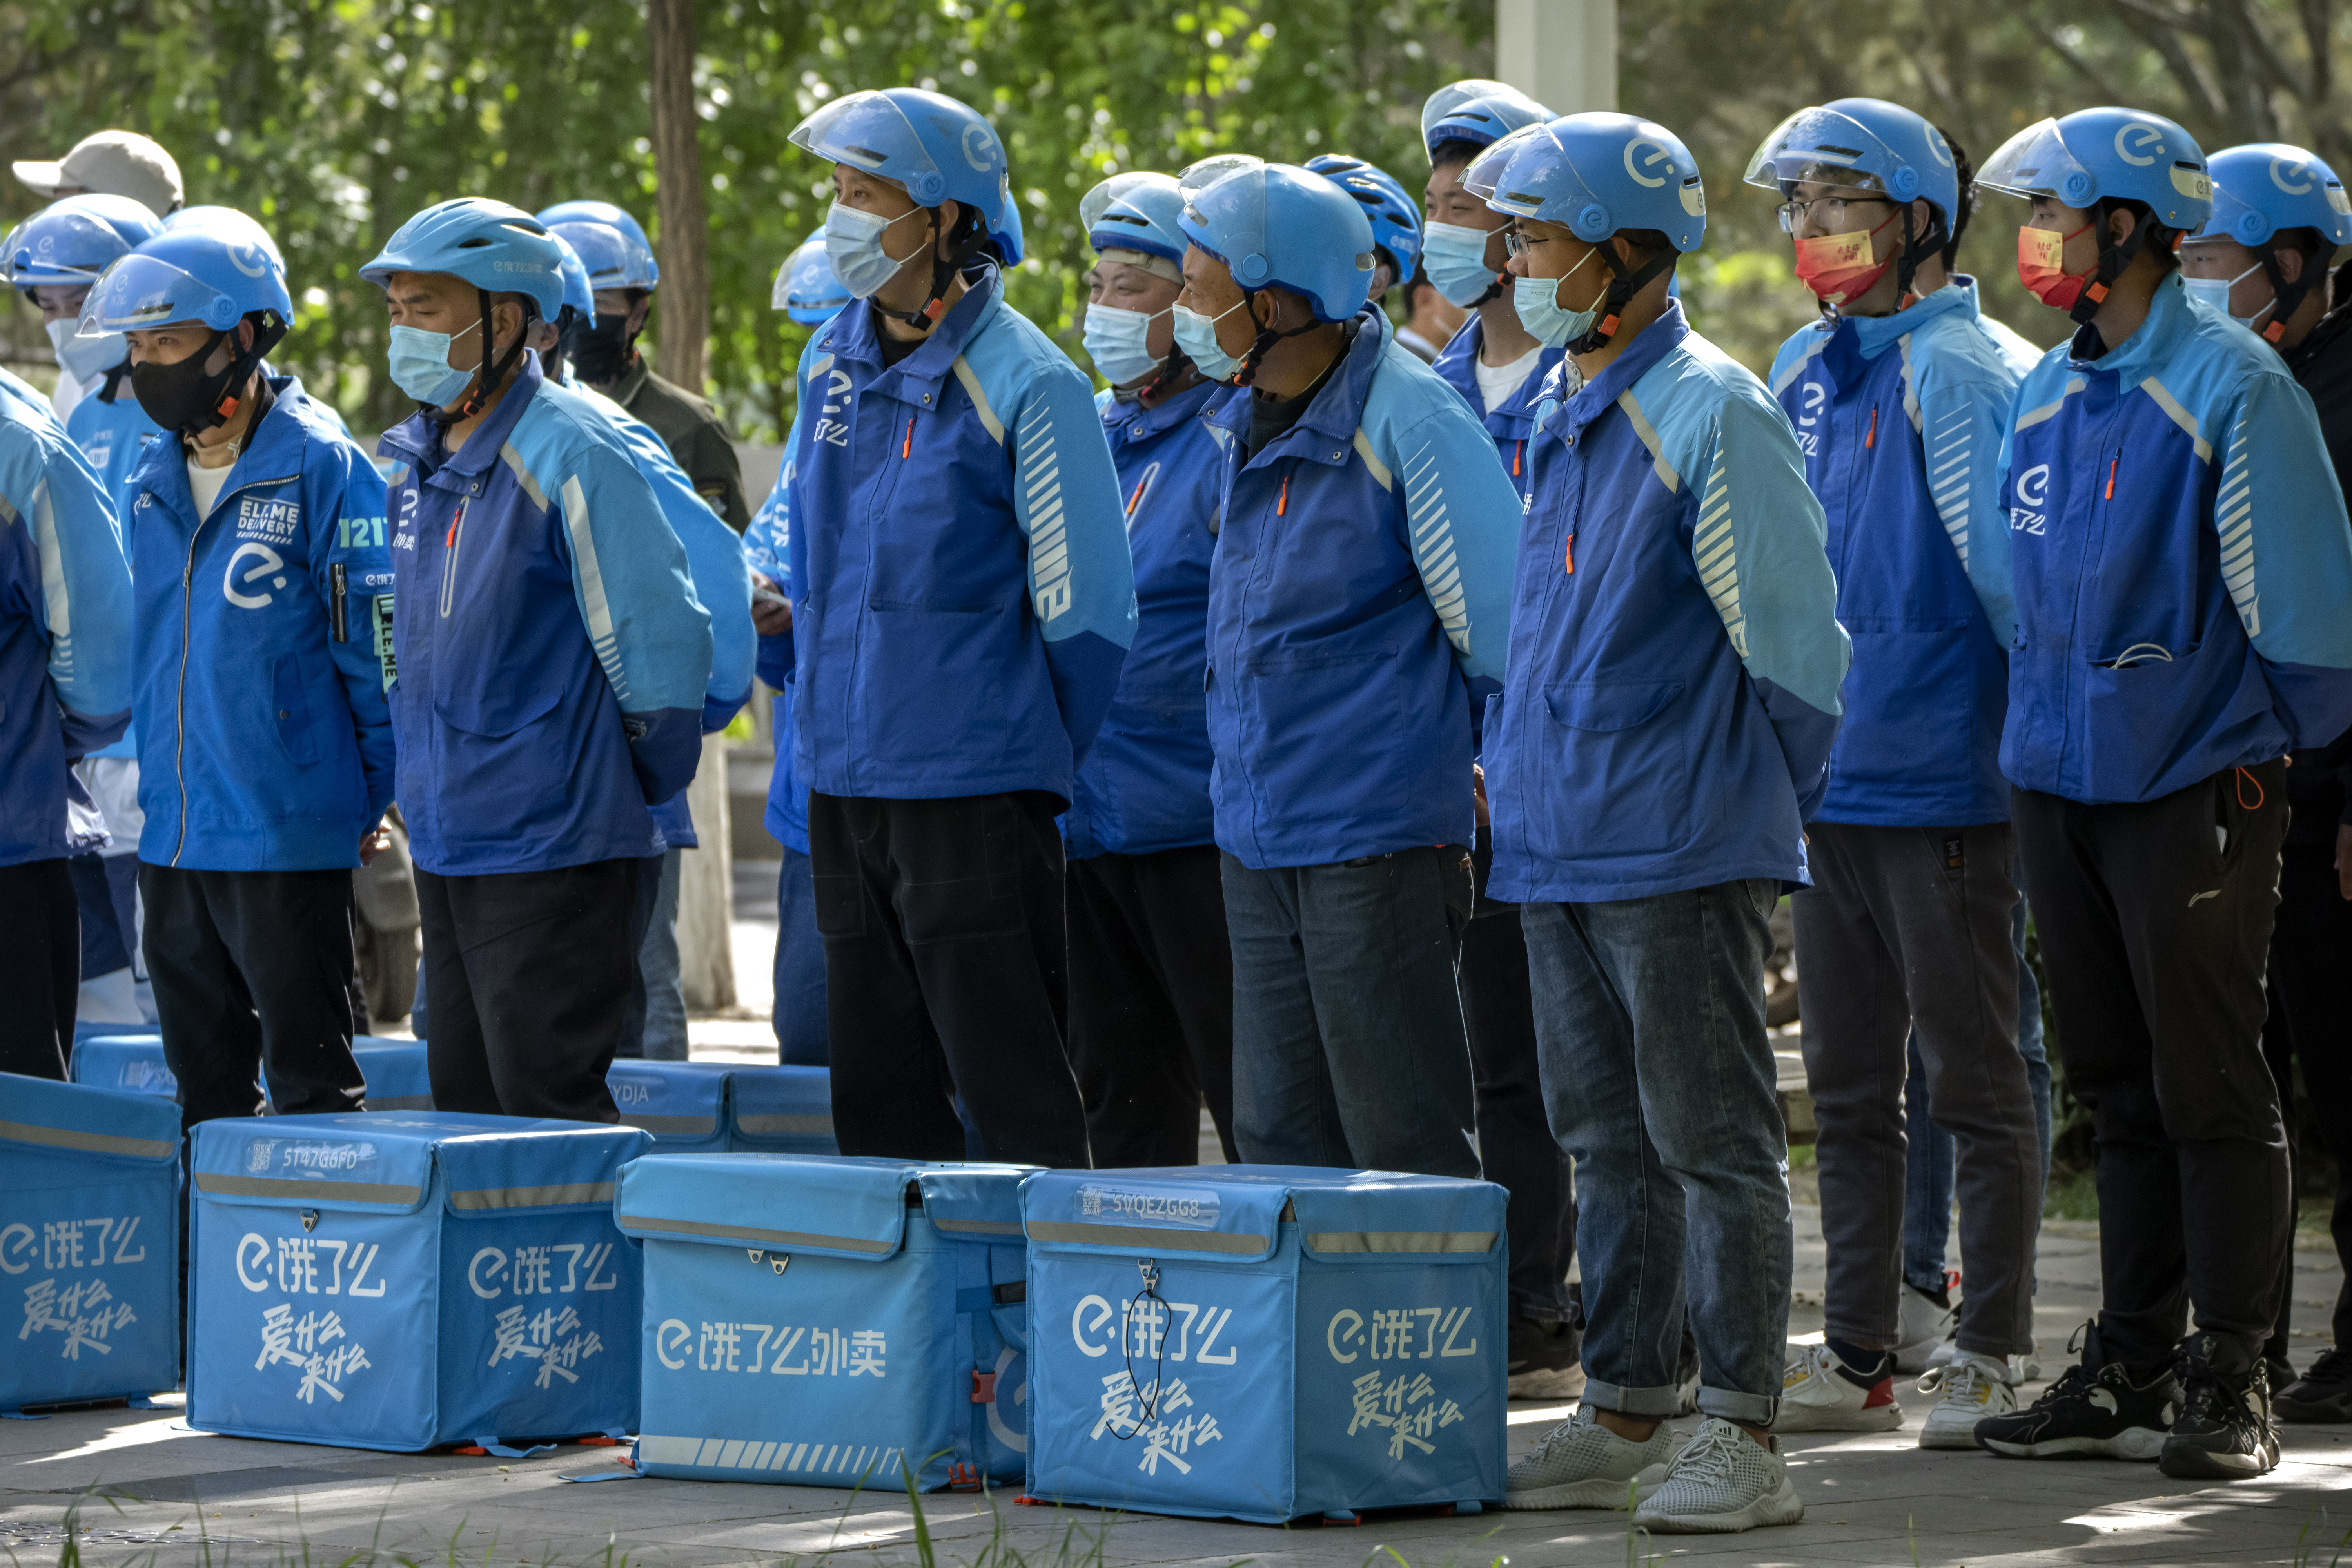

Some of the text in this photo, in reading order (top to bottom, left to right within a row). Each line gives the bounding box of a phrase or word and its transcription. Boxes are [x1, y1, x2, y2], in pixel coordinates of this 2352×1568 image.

[813, 418, 848, 446] 了么
[339, 517, 387, 548] 121
[609, 1084, 649, 1105] YDJA
